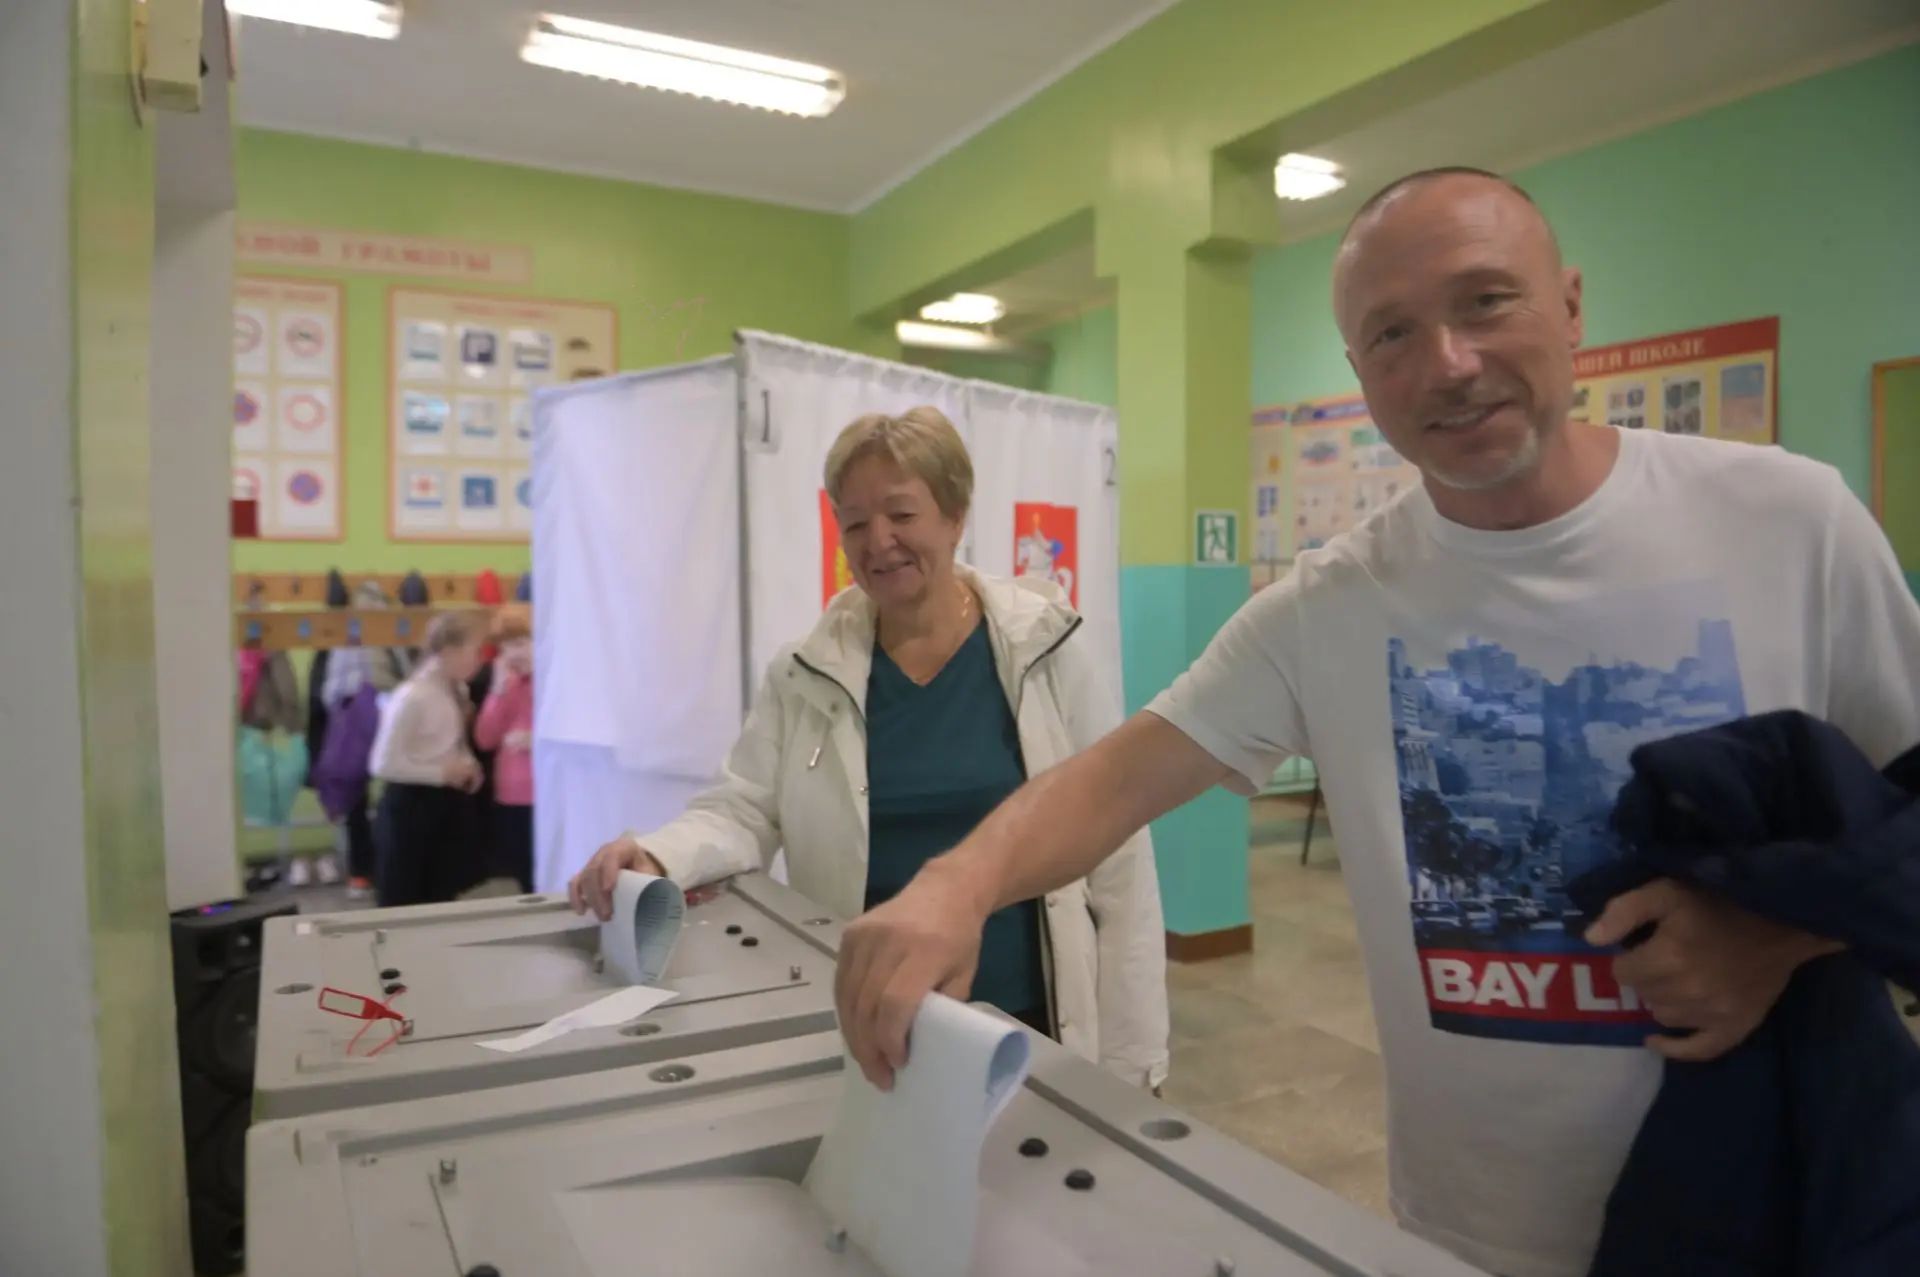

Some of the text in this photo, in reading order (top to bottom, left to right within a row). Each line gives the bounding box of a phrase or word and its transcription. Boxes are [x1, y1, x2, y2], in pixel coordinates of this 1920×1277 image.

[1629, 338, 1705, 365] ШКОЛЕ
[1104, 447, 1117, 486] 2
[1427, 958, 1560, 1009] BAY
